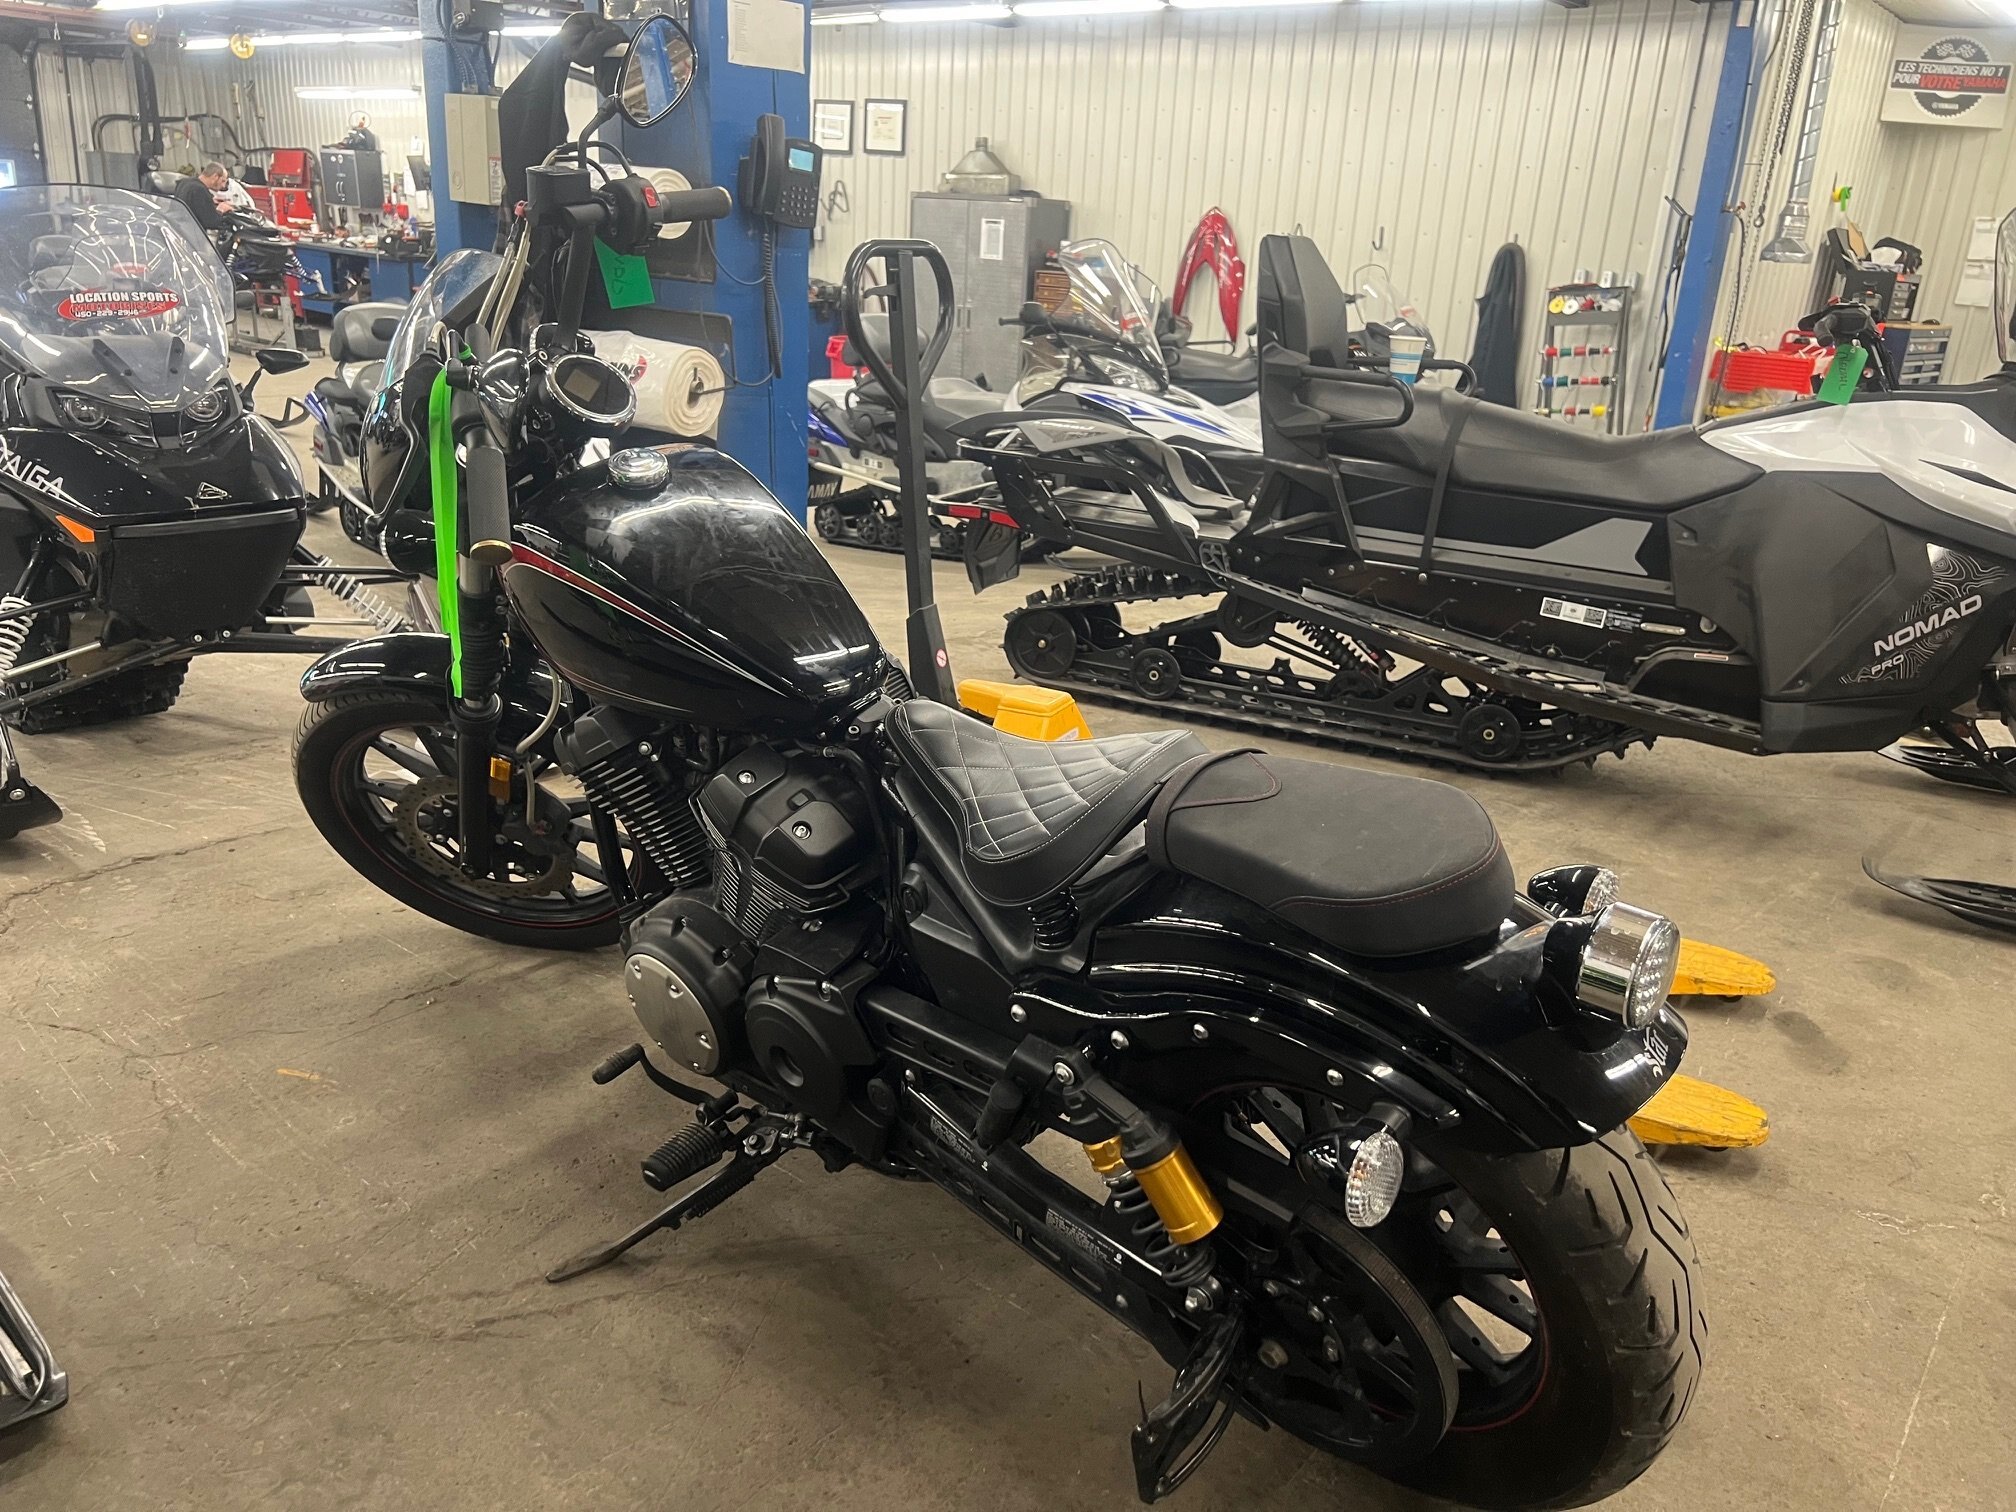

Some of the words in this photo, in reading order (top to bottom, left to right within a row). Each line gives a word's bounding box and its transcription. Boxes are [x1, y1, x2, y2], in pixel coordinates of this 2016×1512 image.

[1898, 62, 1916, 72] LES
[1918, 62, 1979, 76] TECHNICIENS
[1997, 67, 2004, 77] 1
[1893, 73, 1920, 84] POUR
[1920, 74, 1961, 90] VOTRE
[70, 292, 129, 303] LOCATION
[132, 291, 179, 303] SPORTS
[1873, 594, 1983, 657] NOMAD
[1871, 654, 1905, 675] PRO
